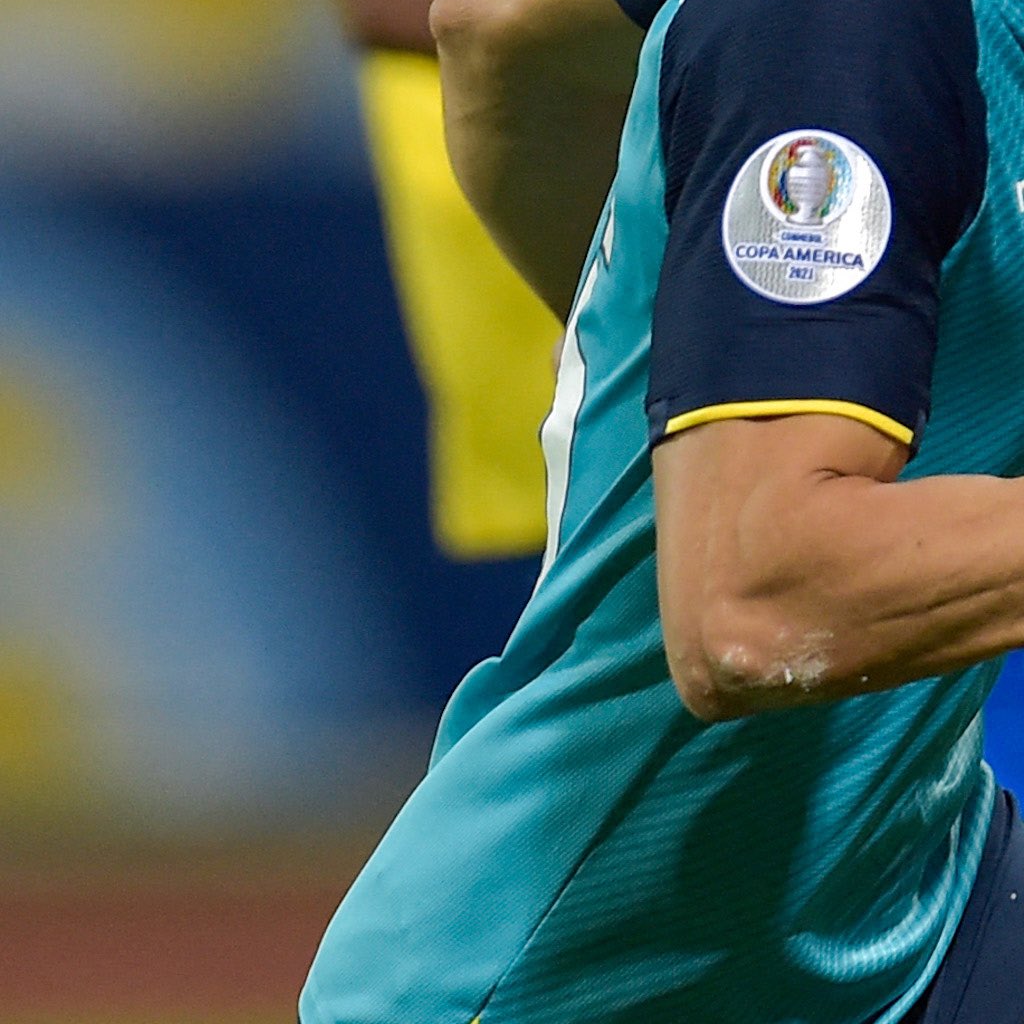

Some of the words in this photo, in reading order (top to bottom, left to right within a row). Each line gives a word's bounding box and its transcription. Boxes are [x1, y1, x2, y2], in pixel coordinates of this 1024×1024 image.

[735, 244, 779, 260] COPA
[783, 247, 865, 268] AMERICA
[789, 266, 813, 280] 2021
